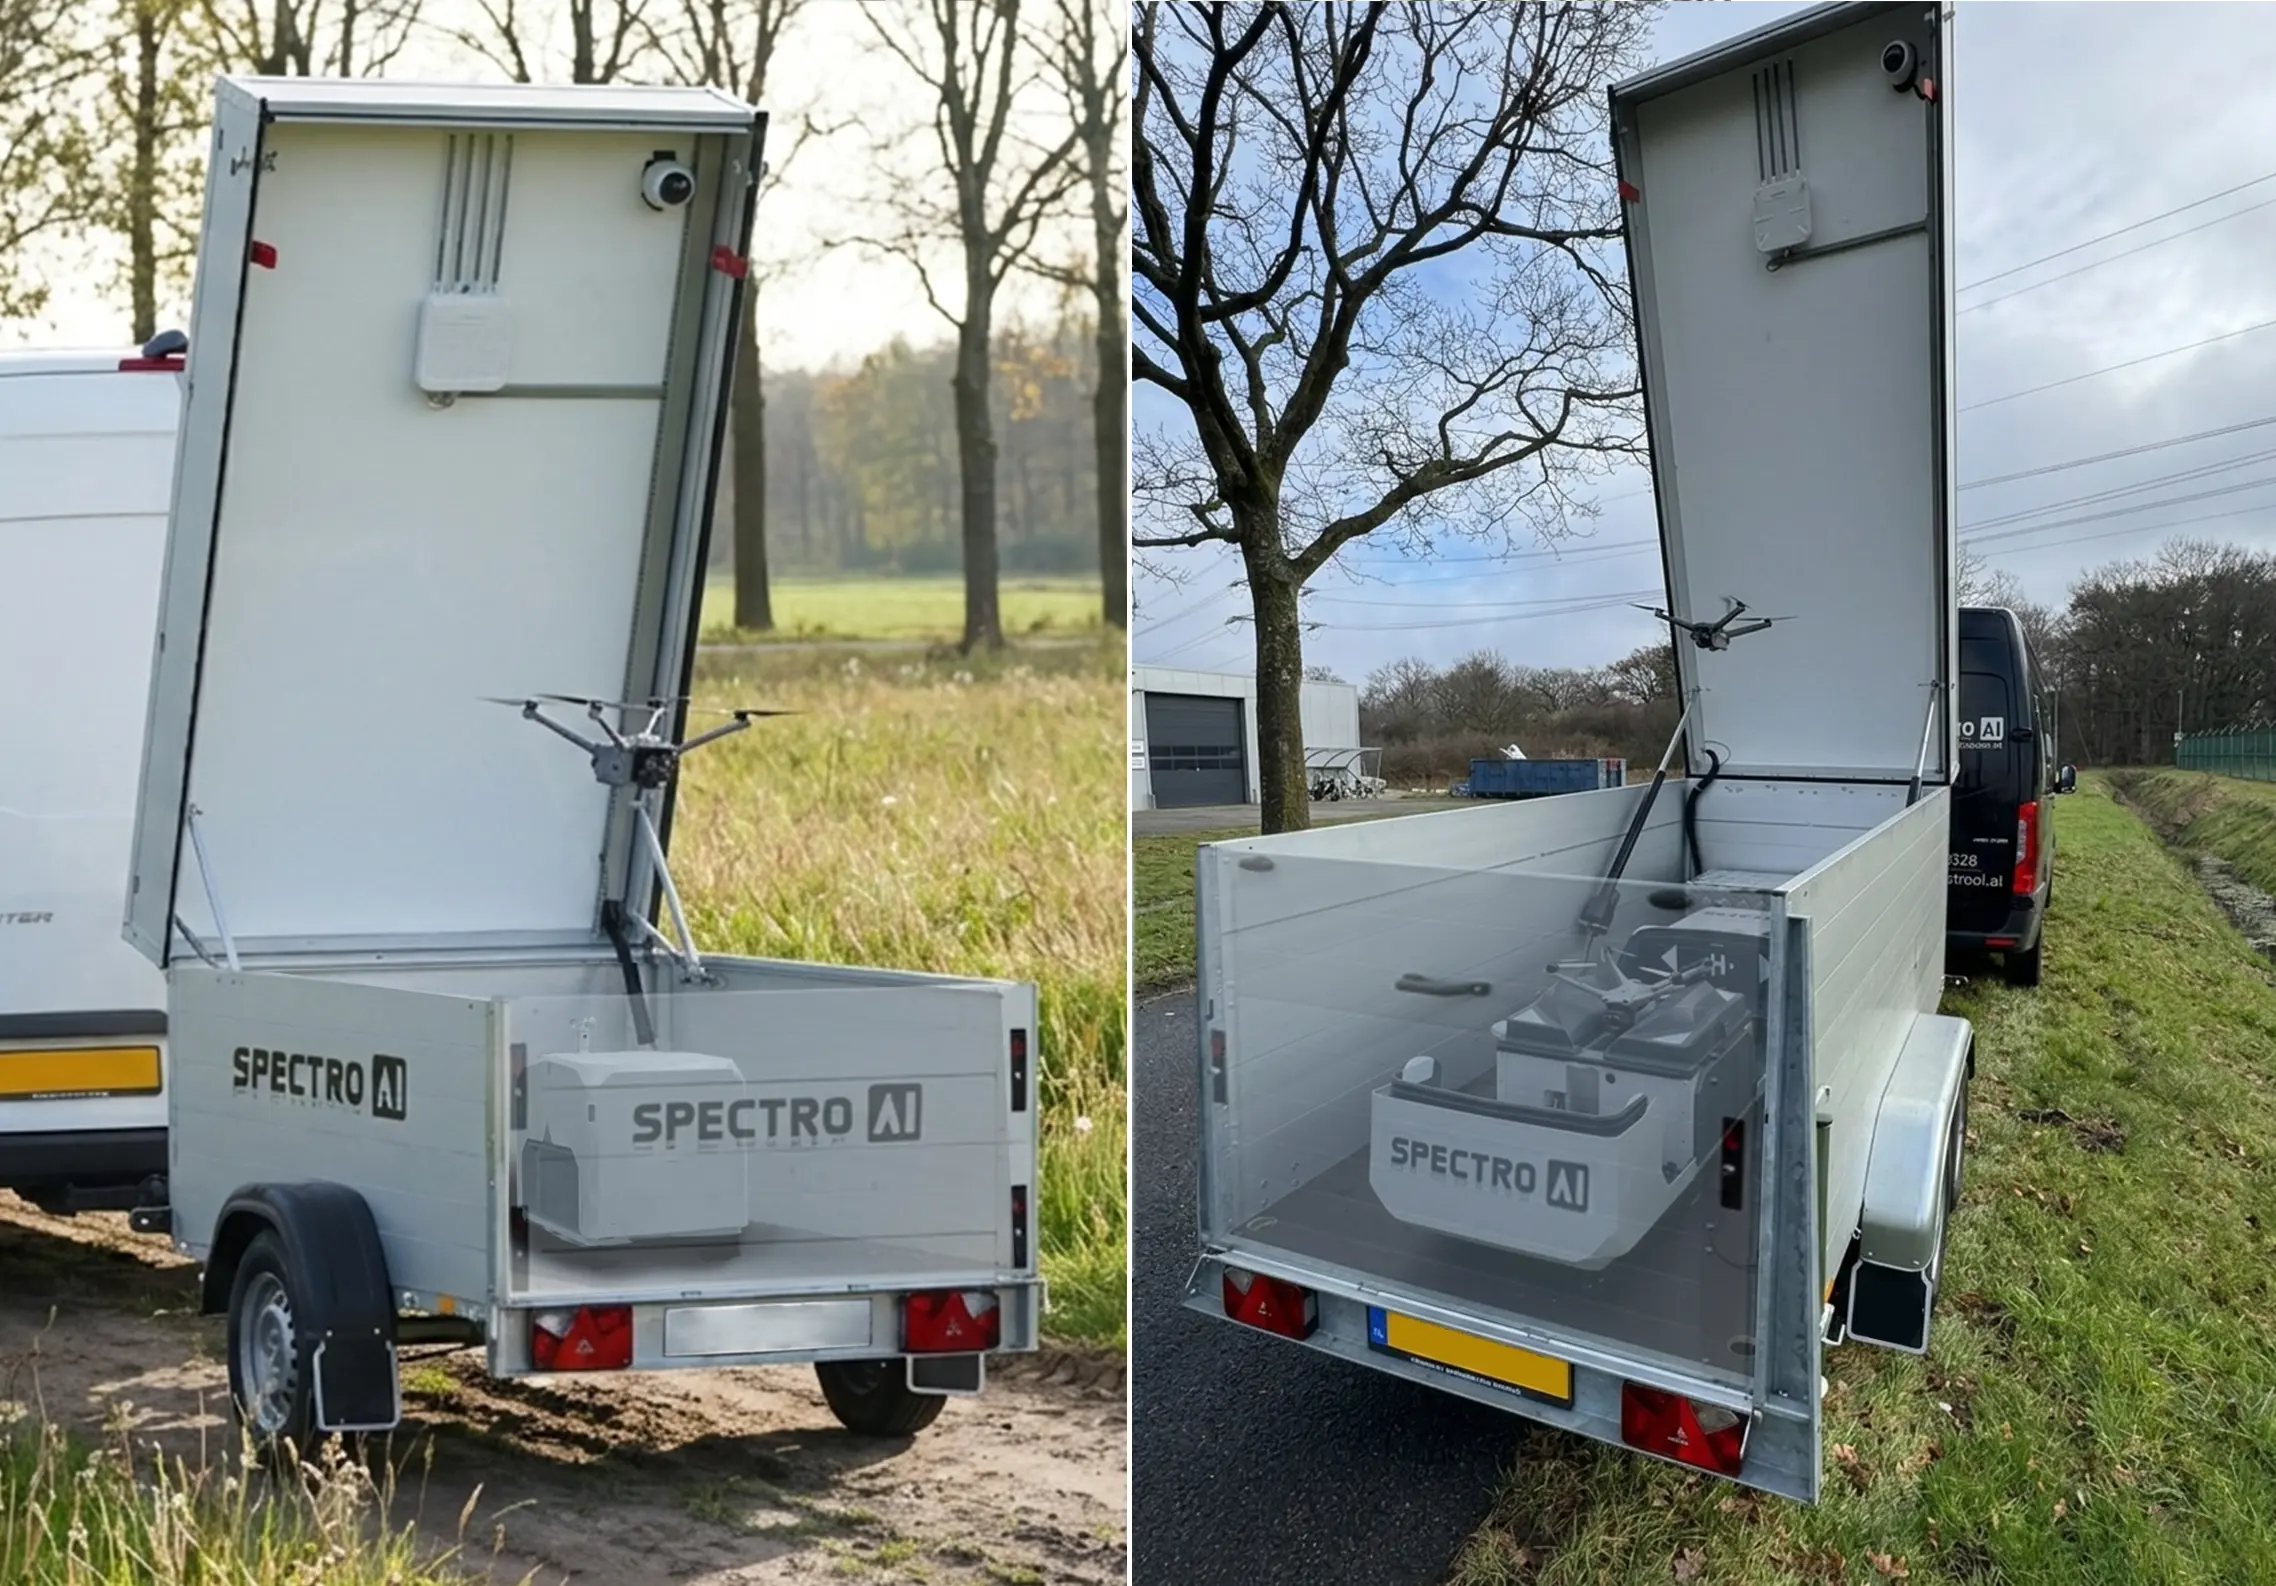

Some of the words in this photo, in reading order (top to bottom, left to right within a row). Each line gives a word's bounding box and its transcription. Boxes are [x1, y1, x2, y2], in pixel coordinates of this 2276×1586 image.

[1981, 719, 2002, 739] AI
[233, 1046, 364, 1106] SPECTRO
[375, 1060, 404, 1115] AI
[632, 1097, 853, 1143] SPECTRO
[871, 1087, 919, 1138] AI
[1390, 1137, 1536, 1193] SPECTRO
[1549, 1164, 1586, 1209] AI
